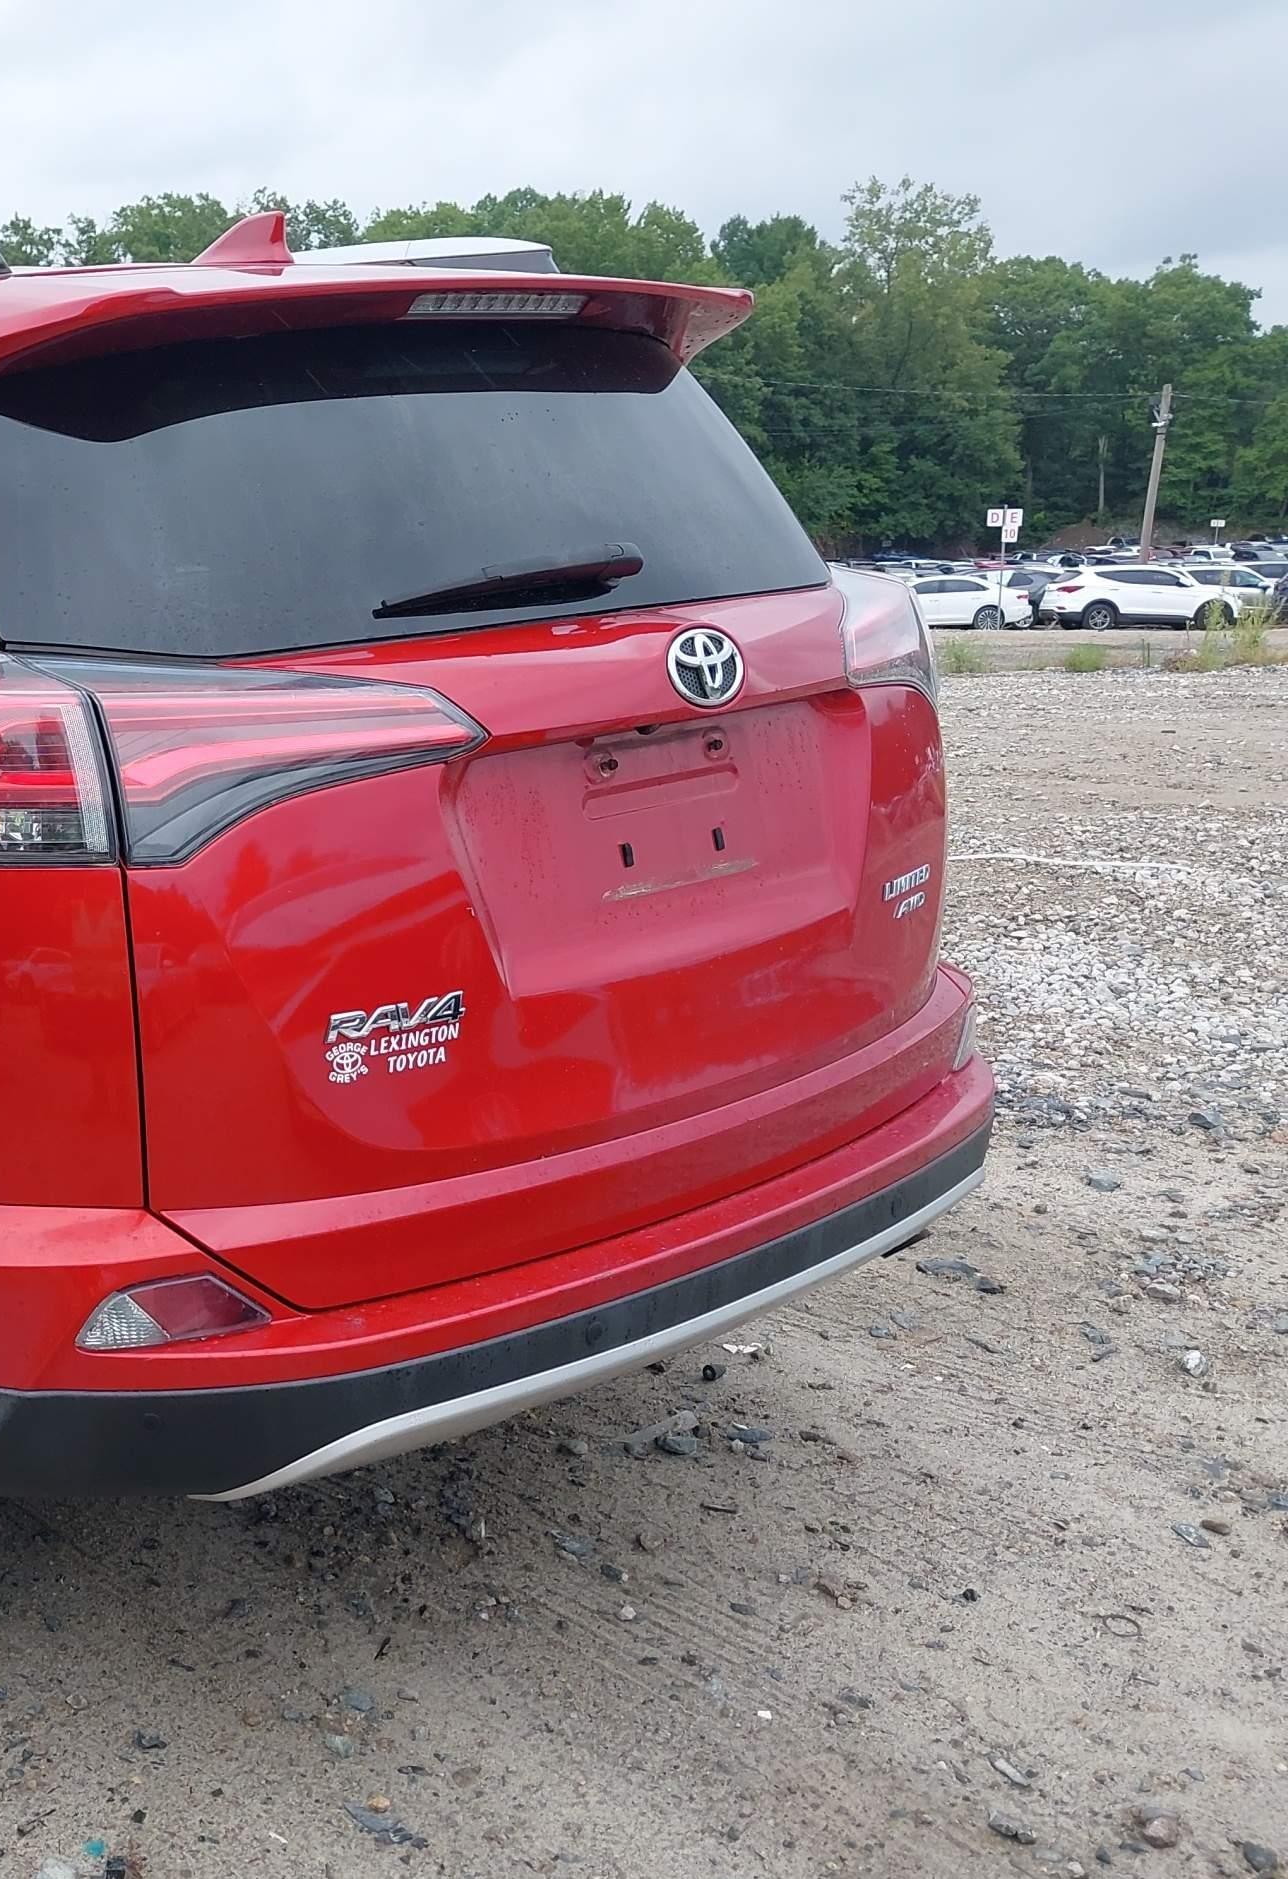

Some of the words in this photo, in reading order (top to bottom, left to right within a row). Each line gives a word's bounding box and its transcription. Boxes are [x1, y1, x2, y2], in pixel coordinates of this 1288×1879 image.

[991, 512, 1000, 523] D
[1010, 512, 1018, 523] E
[1004, 529, 1016, 538] 10
[325, 990, 466, 1043] RAV4
[369, 1022, 460, 1057] LEXINGTON
[325, 1042, 369, 1062] GEORGE
[387, 1046, 446, 1074] TOYOTA
[328, 1064, 369, 1084] GREY'S
